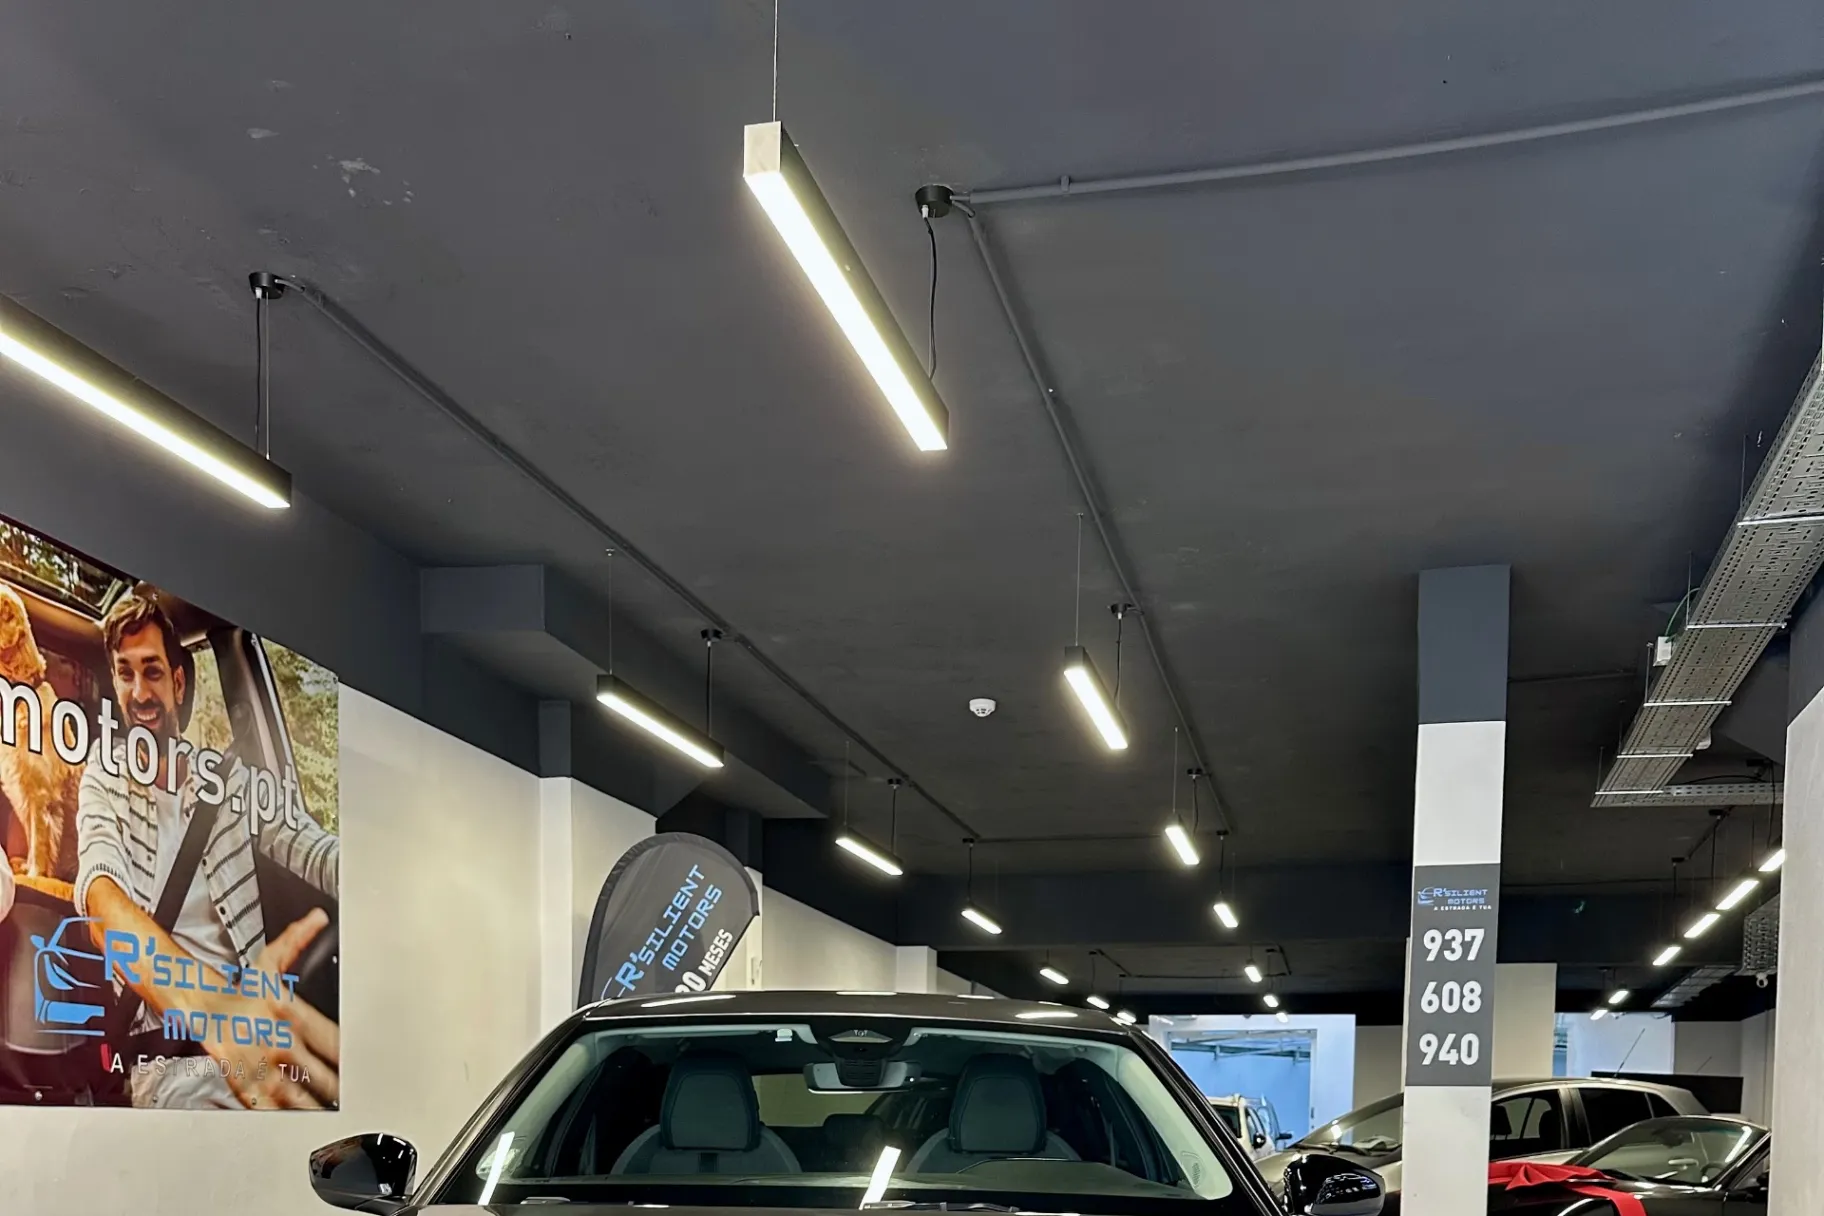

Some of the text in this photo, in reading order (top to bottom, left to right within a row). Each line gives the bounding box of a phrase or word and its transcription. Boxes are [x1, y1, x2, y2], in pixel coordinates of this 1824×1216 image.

[662, 884, 723, 971] MOTORS
[1423, 928, 1485, 962] 937
[105, 930, 300, 1002] R'SILIENT
[698, 928, 734, 977] MESES
[1421, 981, 1482, 1014] 608
[163, 1008, 293, 1049] MOTORS
[1419, 1033, 1480, 1066] 940
[110, 1053, 124, 1074] A
[137, 1054, 246, 1080] ESTRADA
[279, 1063, 312, 1084] TUA
